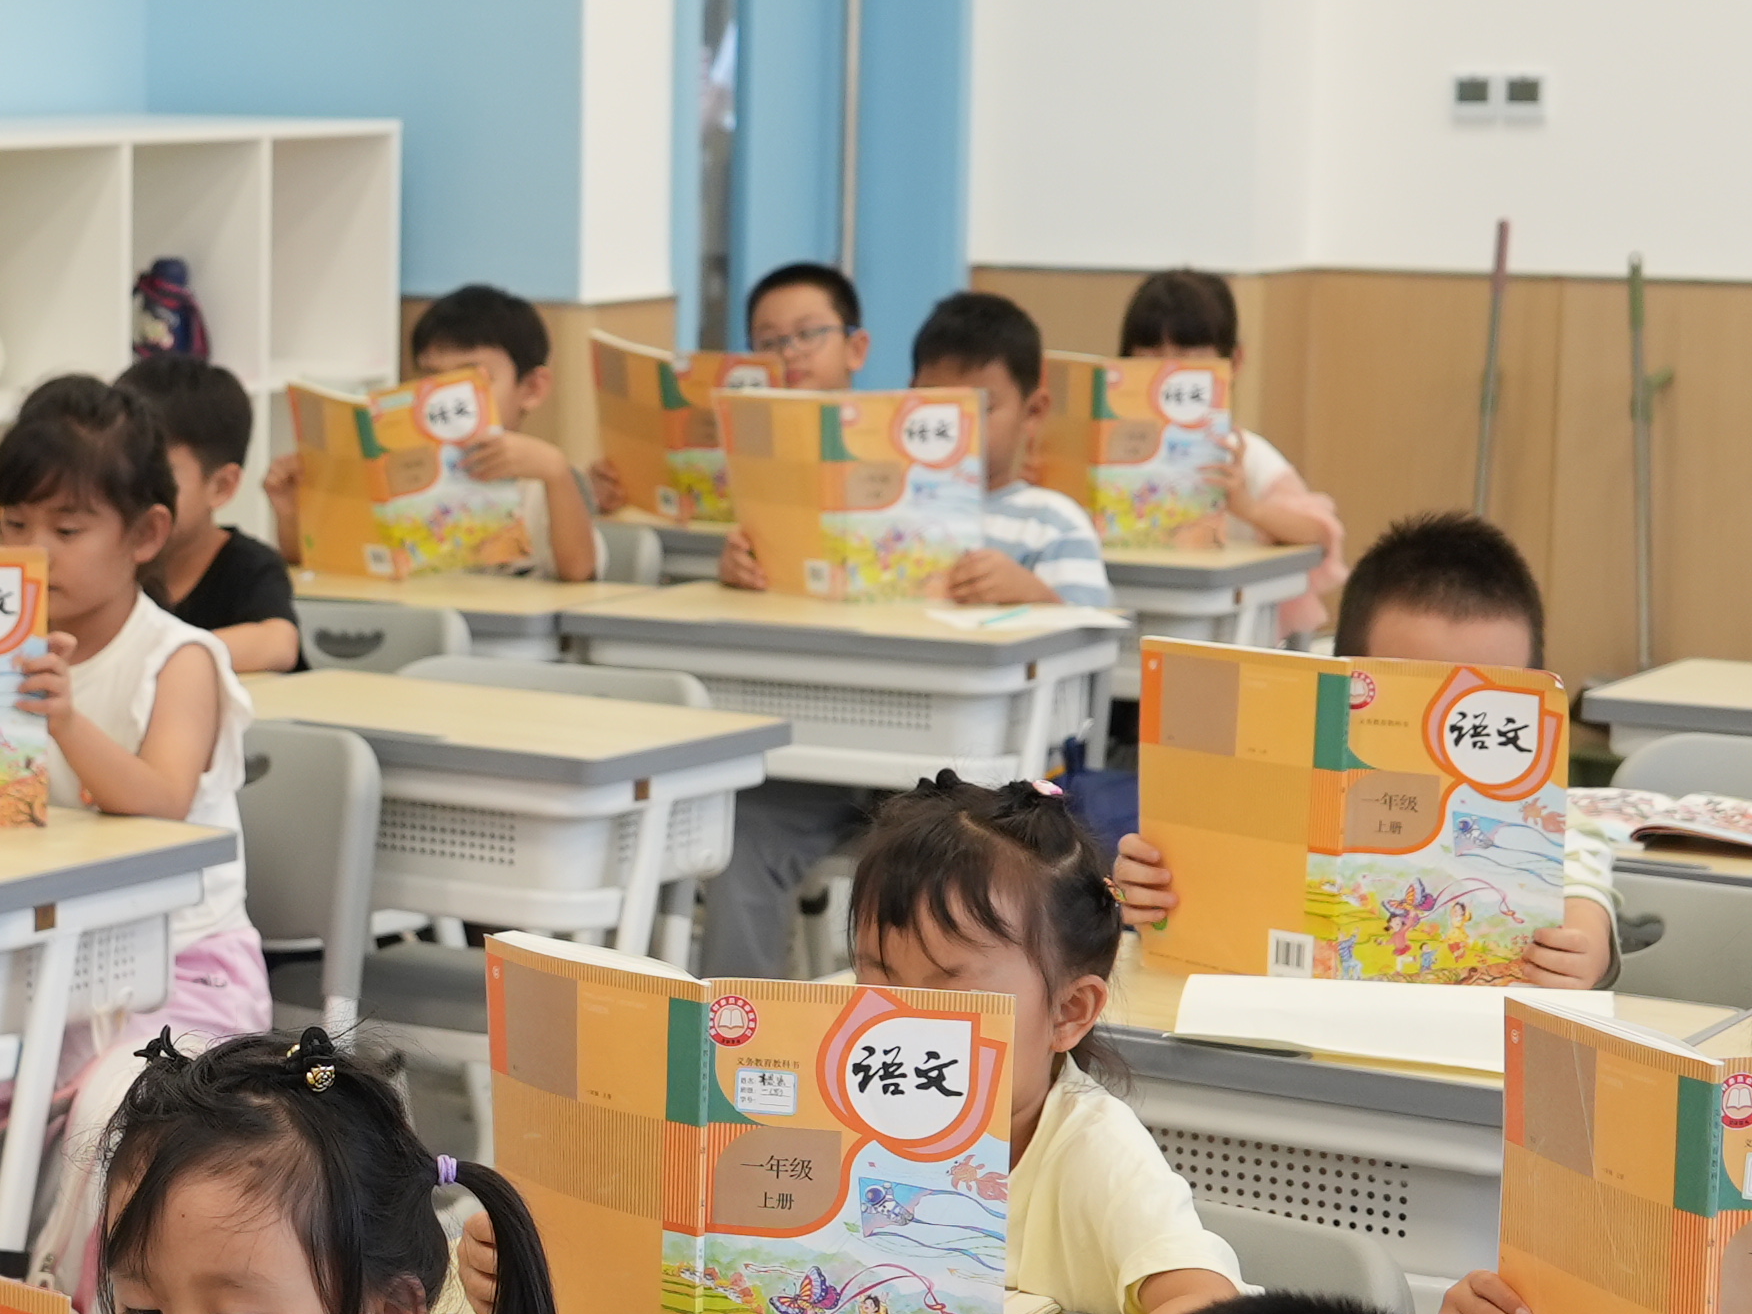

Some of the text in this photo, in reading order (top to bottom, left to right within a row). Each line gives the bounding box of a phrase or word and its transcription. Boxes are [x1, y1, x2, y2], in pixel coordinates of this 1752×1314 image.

[1449, 711, 1533, 753] 语文
[1361, 792, 1419, 813] 一年级
[1374, 820, 1403, 835] 上册
[737, 1056, 800, 1069] 义务教育教科书
[852, 1046, 964, 1097] 语文
[740, 1154, 814, 1182] 一年级
[757, 1191, 795, 1211] 上册
